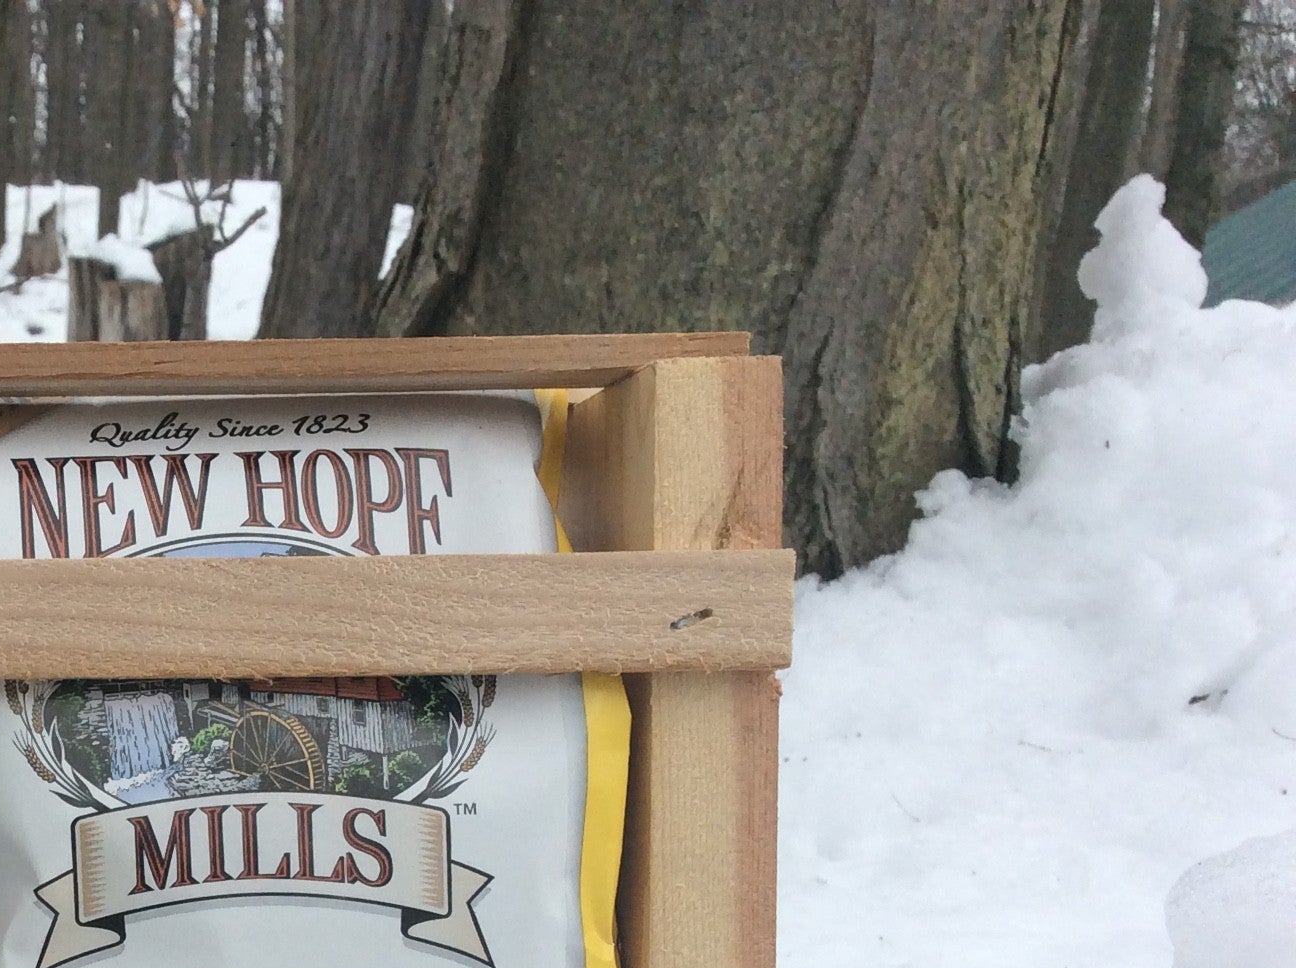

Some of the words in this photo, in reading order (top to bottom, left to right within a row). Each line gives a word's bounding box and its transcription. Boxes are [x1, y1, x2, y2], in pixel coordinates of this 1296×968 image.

[89, 411, 200, 451] Quality
[208, 416, 285, 440] Since
[292, 412, 371, 436] 1823
[11, 453, 220, 558] NEW
[127, 802, 393, 896] MILLS
